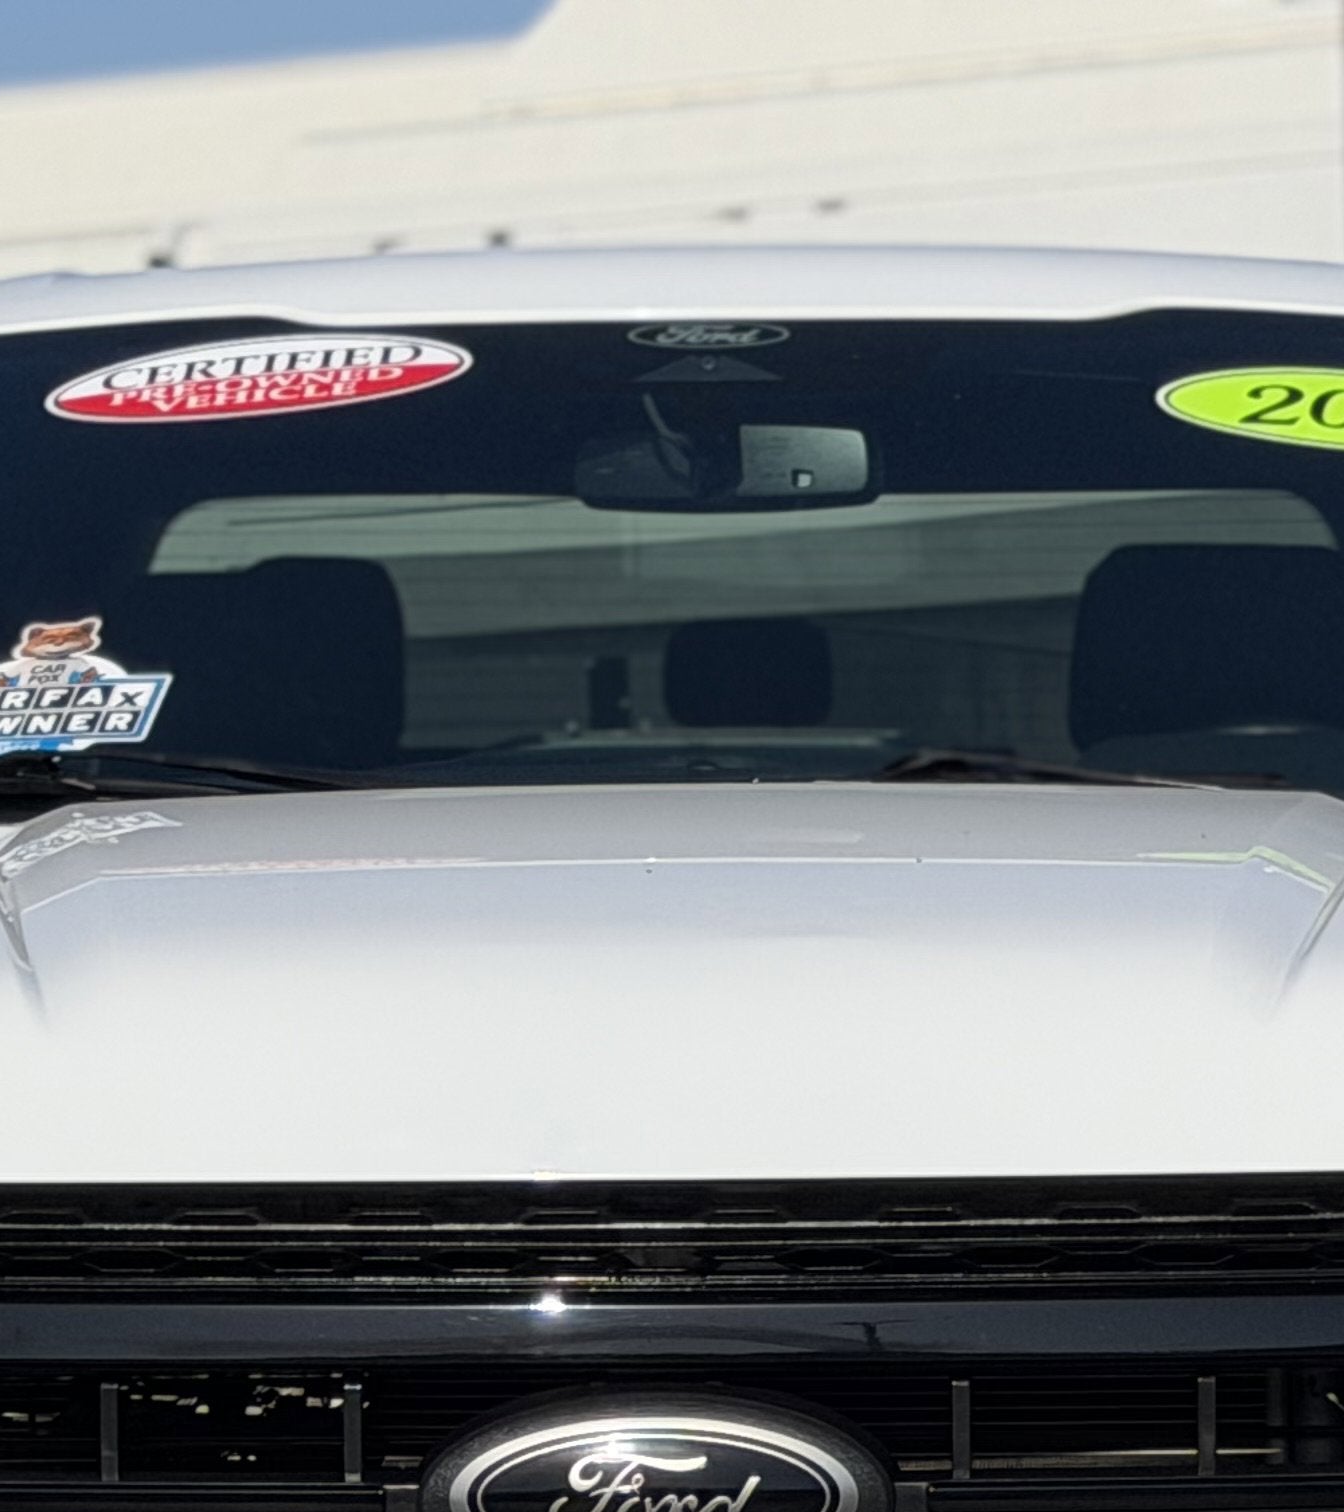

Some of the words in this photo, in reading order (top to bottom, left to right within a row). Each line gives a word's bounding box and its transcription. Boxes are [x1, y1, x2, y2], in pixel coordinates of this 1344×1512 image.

[101, 344, 423, 391] CERTIFIED
[109, 366, 405, 408] PRE-OWNED
[149, 380, 358, 413] VEHICLE
